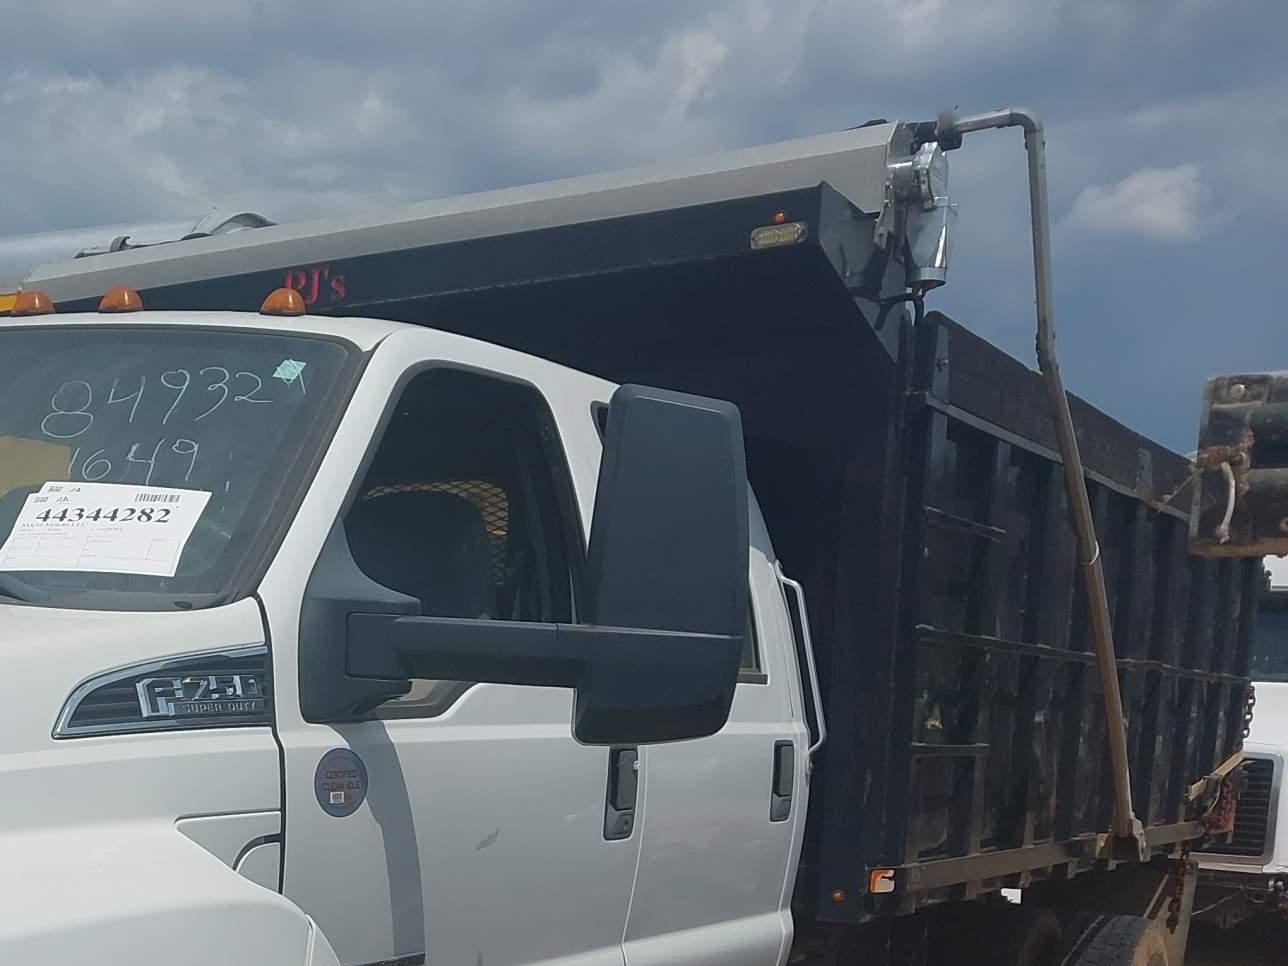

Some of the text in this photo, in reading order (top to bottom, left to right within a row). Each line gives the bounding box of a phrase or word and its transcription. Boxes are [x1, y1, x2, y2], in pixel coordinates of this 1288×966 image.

[41, 366, 273, 439] 84932
[66, 437, 200, 487] 1649
[35, 506, 172, 524] 44344282
[182, 701, 257, 713] SUPER DUTY
